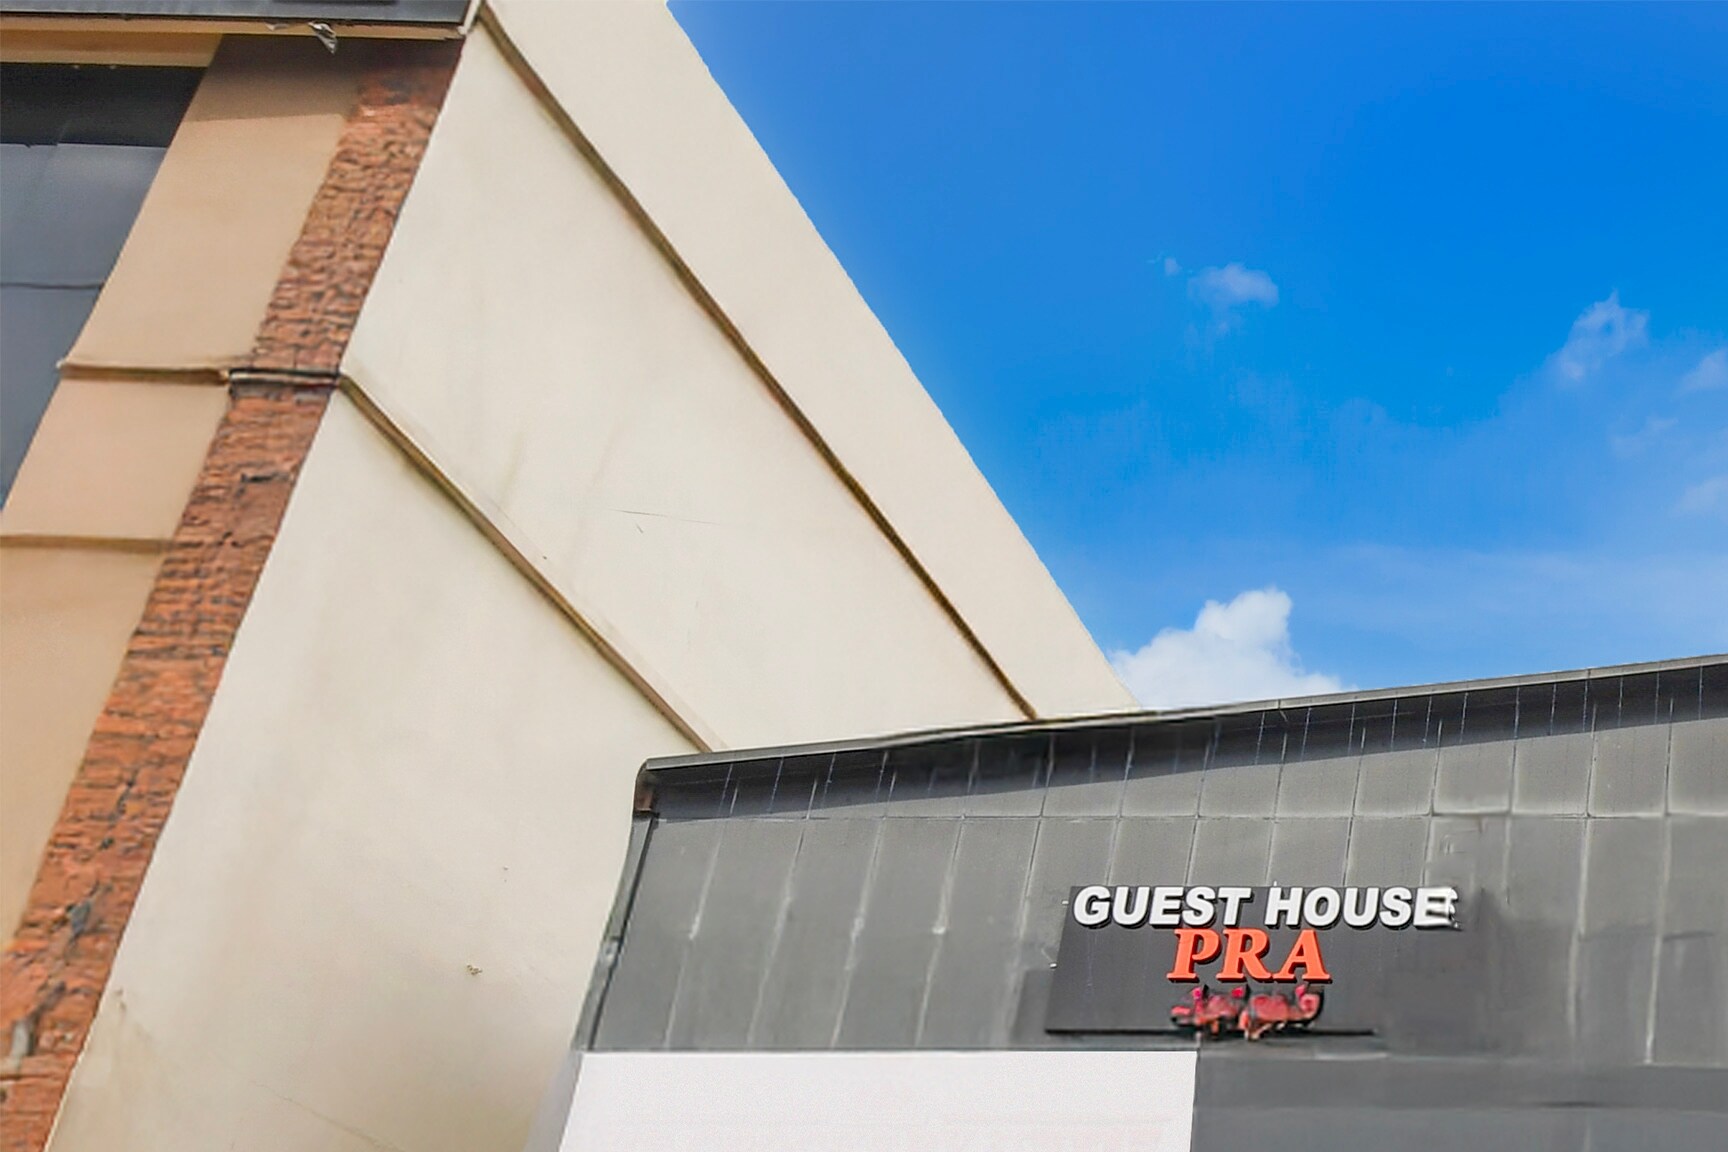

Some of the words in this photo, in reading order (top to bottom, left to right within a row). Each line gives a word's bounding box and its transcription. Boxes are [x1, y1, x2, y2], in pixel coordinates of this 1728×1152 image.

[1073, 886, 1252, 927] GUEST
[1265, 886, 1458, 928] HOUSE
[1166, 927, 1331, 981] PRA
